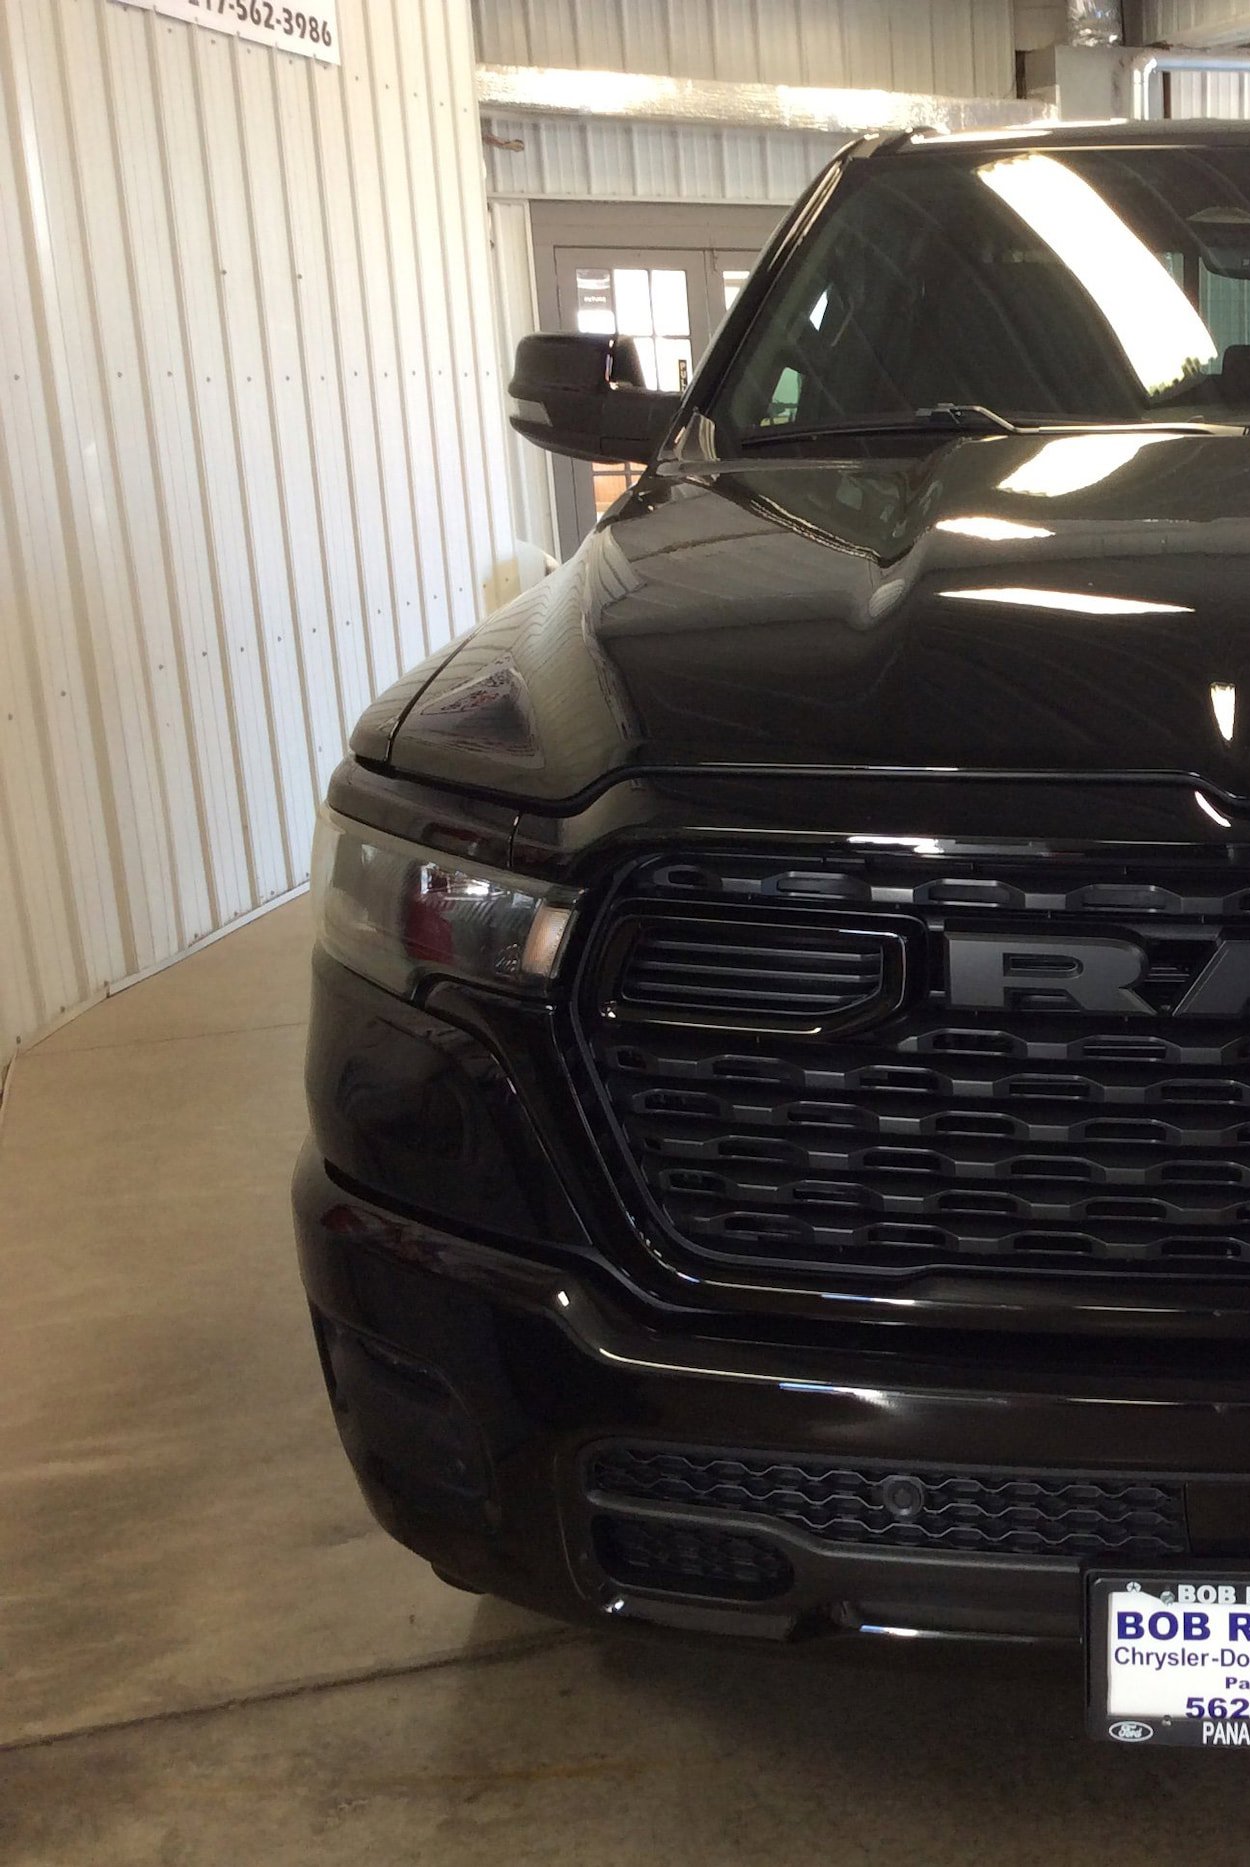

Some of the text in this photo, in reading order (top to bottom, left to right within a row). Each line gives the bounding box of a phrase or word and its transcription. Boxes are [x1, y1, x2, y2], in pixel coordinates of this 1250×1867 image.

[188, 0, 332, 47] -562-3986
[1178, 1584, 1236, 1604] BOB
[1117, 1611, 1210, 1640] BOB
